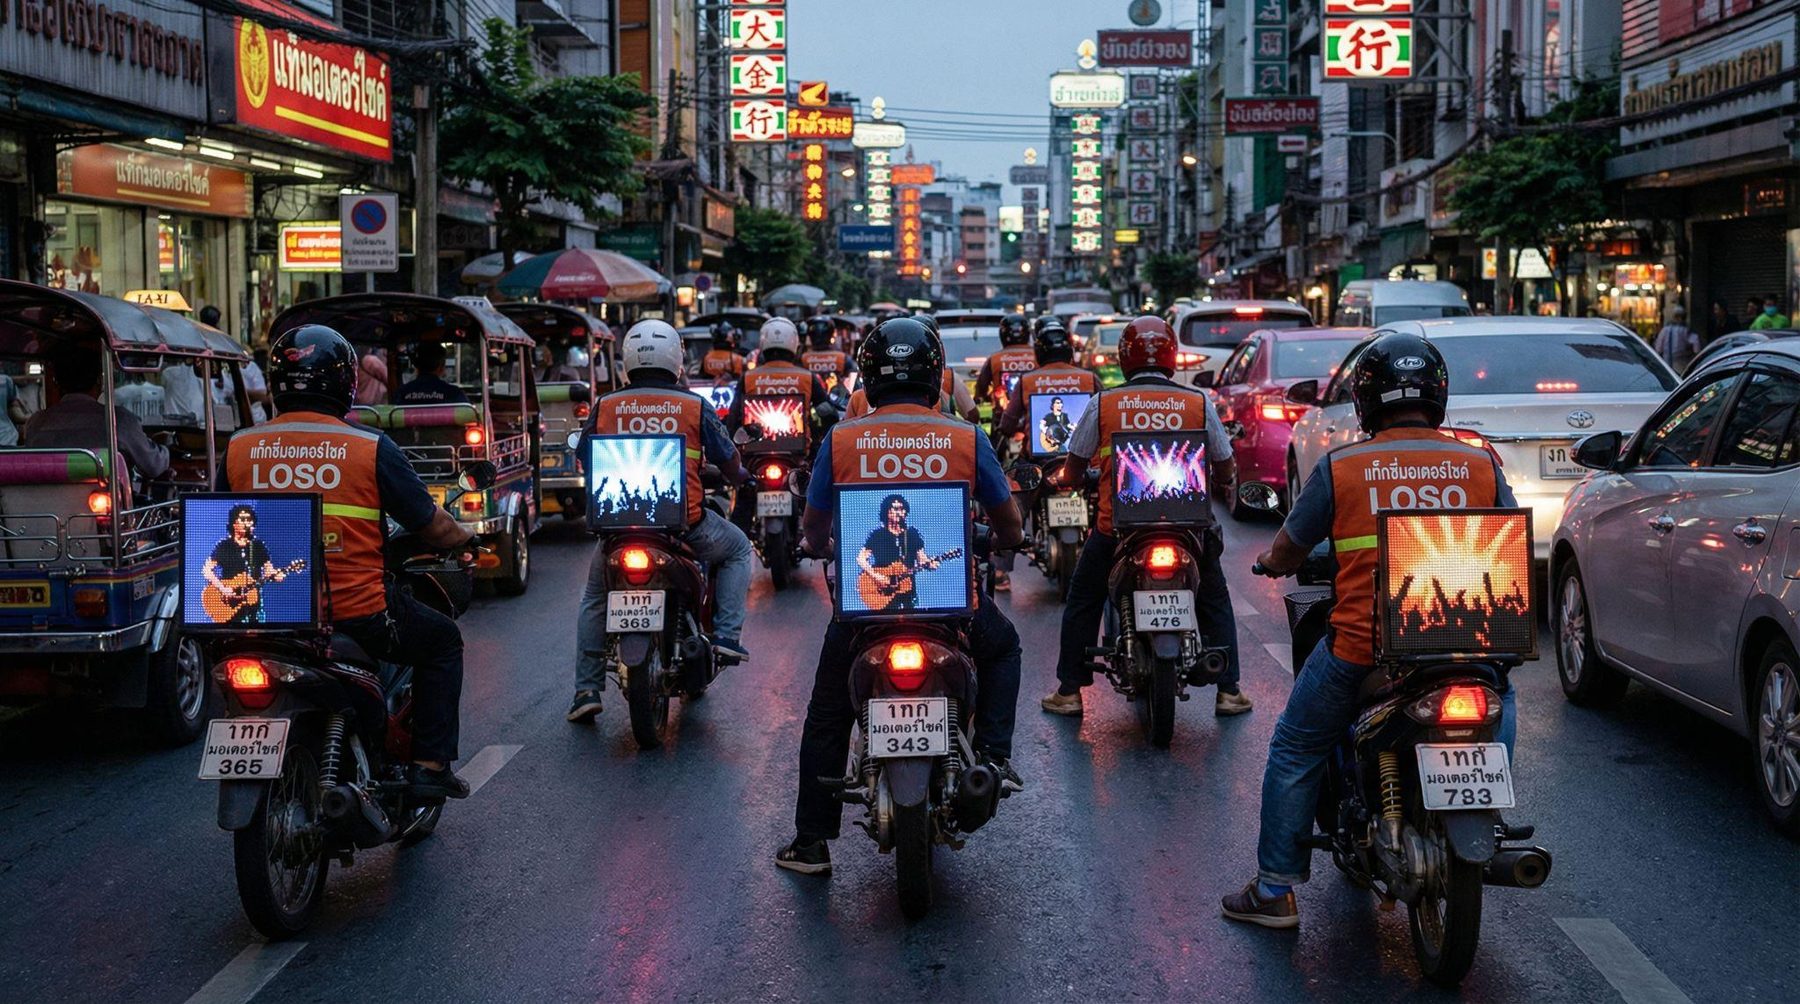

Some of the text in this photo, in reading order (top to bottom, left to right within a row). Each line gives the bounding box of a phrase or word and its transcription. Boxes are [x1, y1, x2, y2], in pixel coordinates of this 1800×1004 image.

[745, 14, 773, 135] 大金行
[1002, 362, 1035, 371] LOSO
[617, 416, 678, 434] LOSO
[1121, 412, 1183, 430] LOSO
[860, 453, 948, 479] LOSO
[252, 463, 341, 489] LOSO
[1369, 484, 1468, 514] LOSO
[620, 617, 651, 629] 368
[1150, 616, 1181, 627] 476
[887, 737, 930, 753] 343
[218, 759, 264, 775] 365
[1443, 788, 1493, 806] 783
